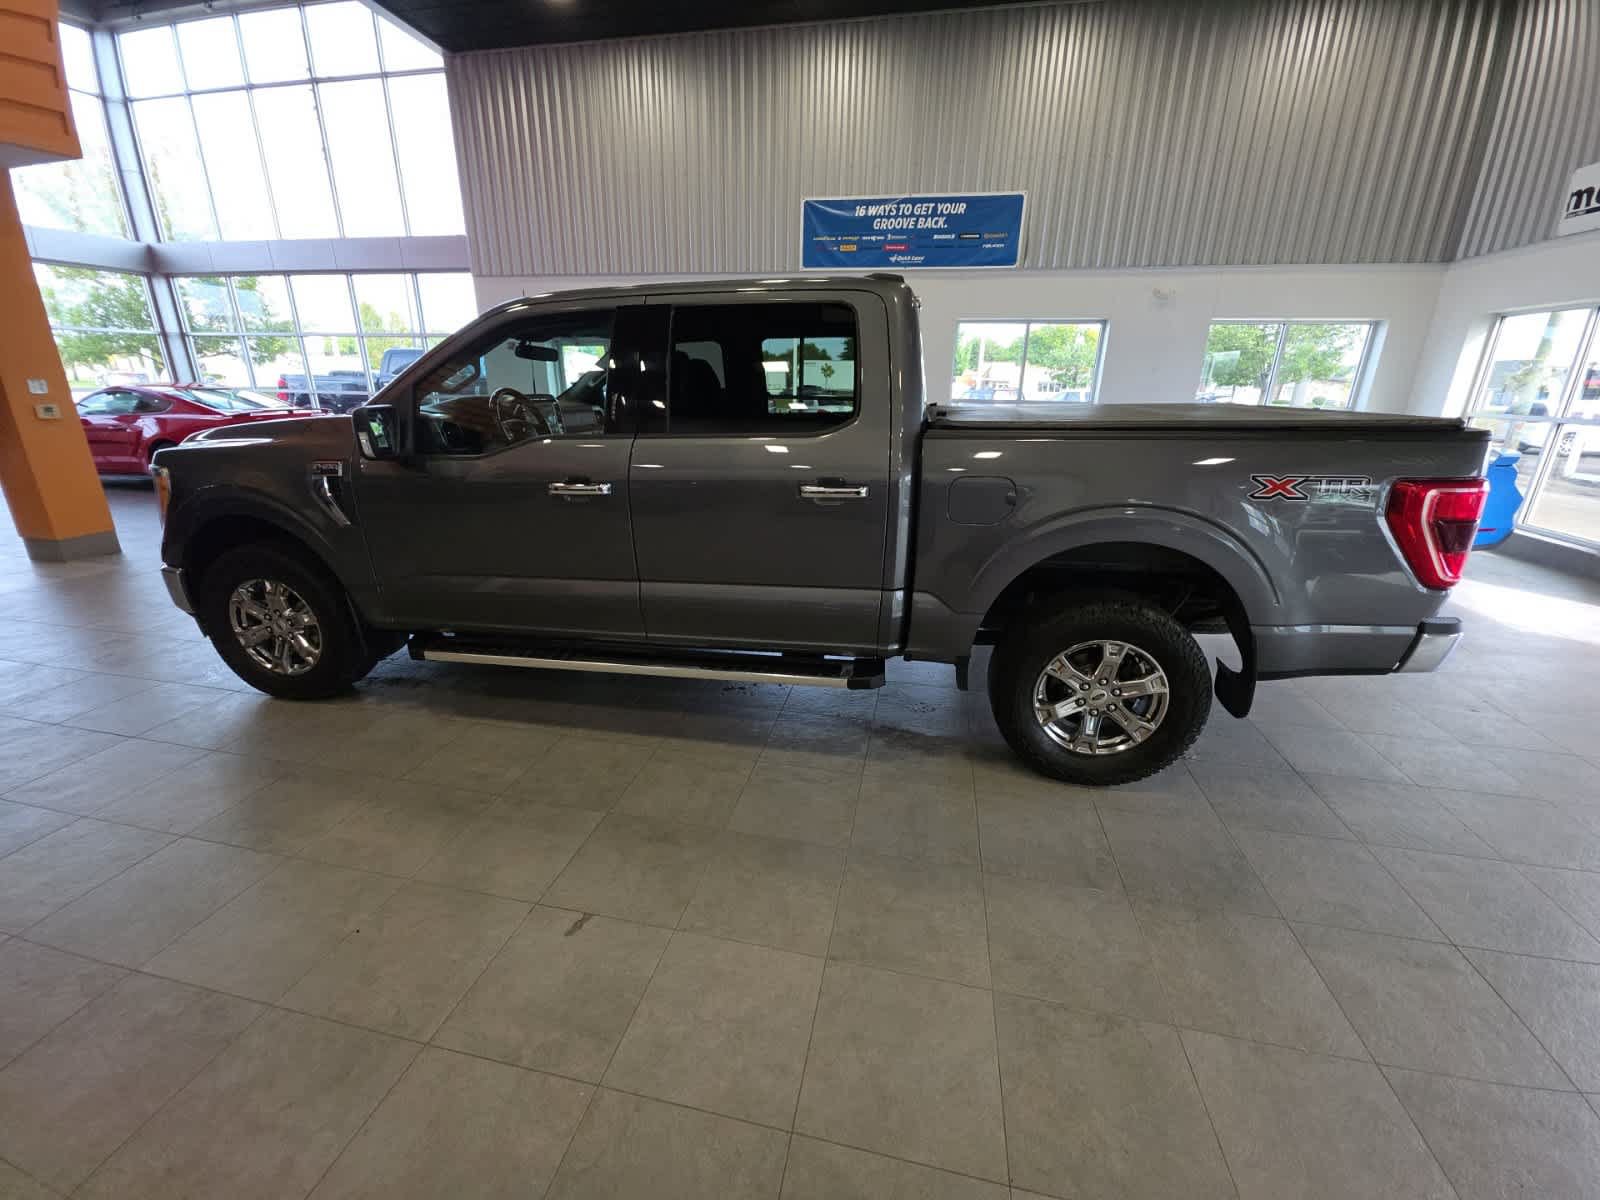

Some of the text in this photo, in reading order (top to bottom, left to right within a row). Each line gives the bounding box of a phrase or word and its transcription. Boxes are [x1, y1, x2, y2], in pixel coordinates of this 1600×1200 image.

[855, 202, 967, 217] 16 WAYS TO GET YOUR
[873, 216, 948, 230] GROOVE BACK.
